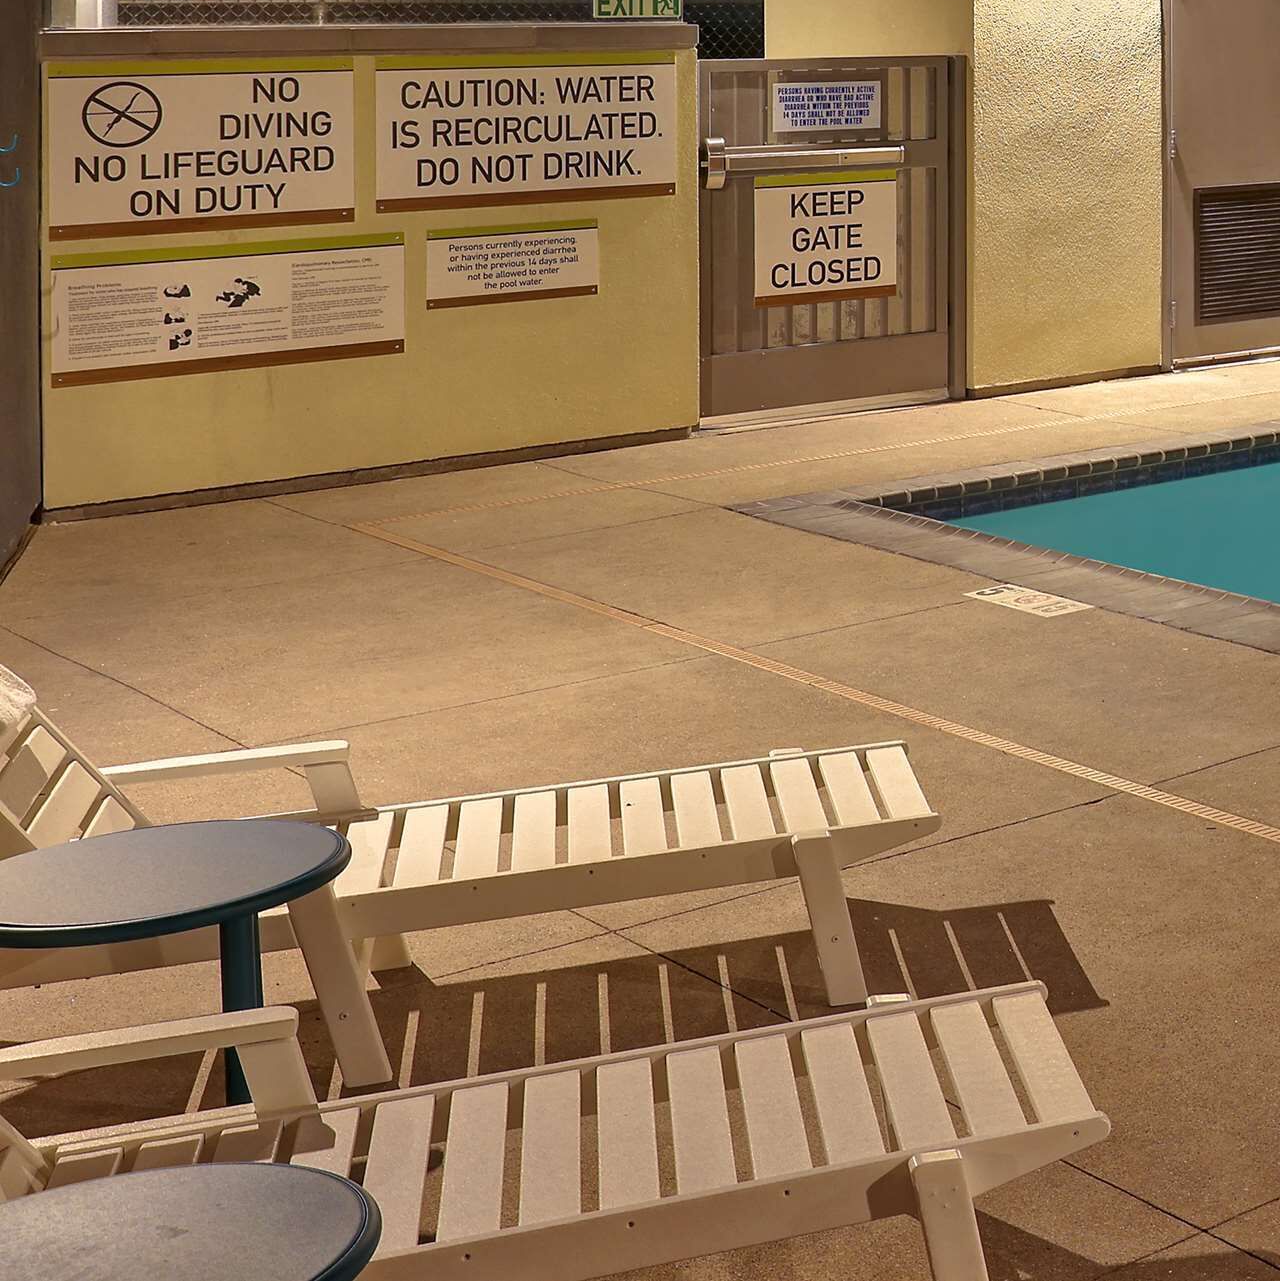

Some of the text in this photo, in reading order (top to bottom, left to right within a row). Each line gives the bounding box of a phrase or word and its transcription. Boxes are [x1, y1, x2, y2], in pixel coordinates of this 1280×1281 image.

[252, 77, 299, 104] NO
[400, 75, 655, 110] CAUTION: WATER
[778, 87, 802, 95] PERSONS
[856, 85, 875, 93] ACTIVE
[779, 95, 805, 103] DIARRHEA
[219, 111, 332, 141] DIVING
[392, 111, 662, 149] IS RECIRCULATED.
[74, 146, 334, 183] NO LIFEGUARD
[417, 149, 642, 187] DO NOT DRINK.
[130, 183, 287, 217] ON DUTY
[790, 190, 865, 218] KEEP
[449, 244, 483, 252] Persons
[485, 240, 522, 249] currently
[792, 223, 863, 252] GATE
[447, 263, 473, 272] within
[474, 262, 488, 270] the
[490, 260, 526, 270] previous
[538, 258, 557, 266] days
[559, 256, 578, 264] shall
[460, 252, 488, 260] having
[490, 248, 540, 259] experienced
[542, 247, 576, 255] diarrhea
[484, 281, 497, 289] the
[499, 279, 517, 289] pool
[494, 269, 527, 278] allowed
[538, 267, 559, 275] enter
[771, 256, 881, 288] CLOSED
